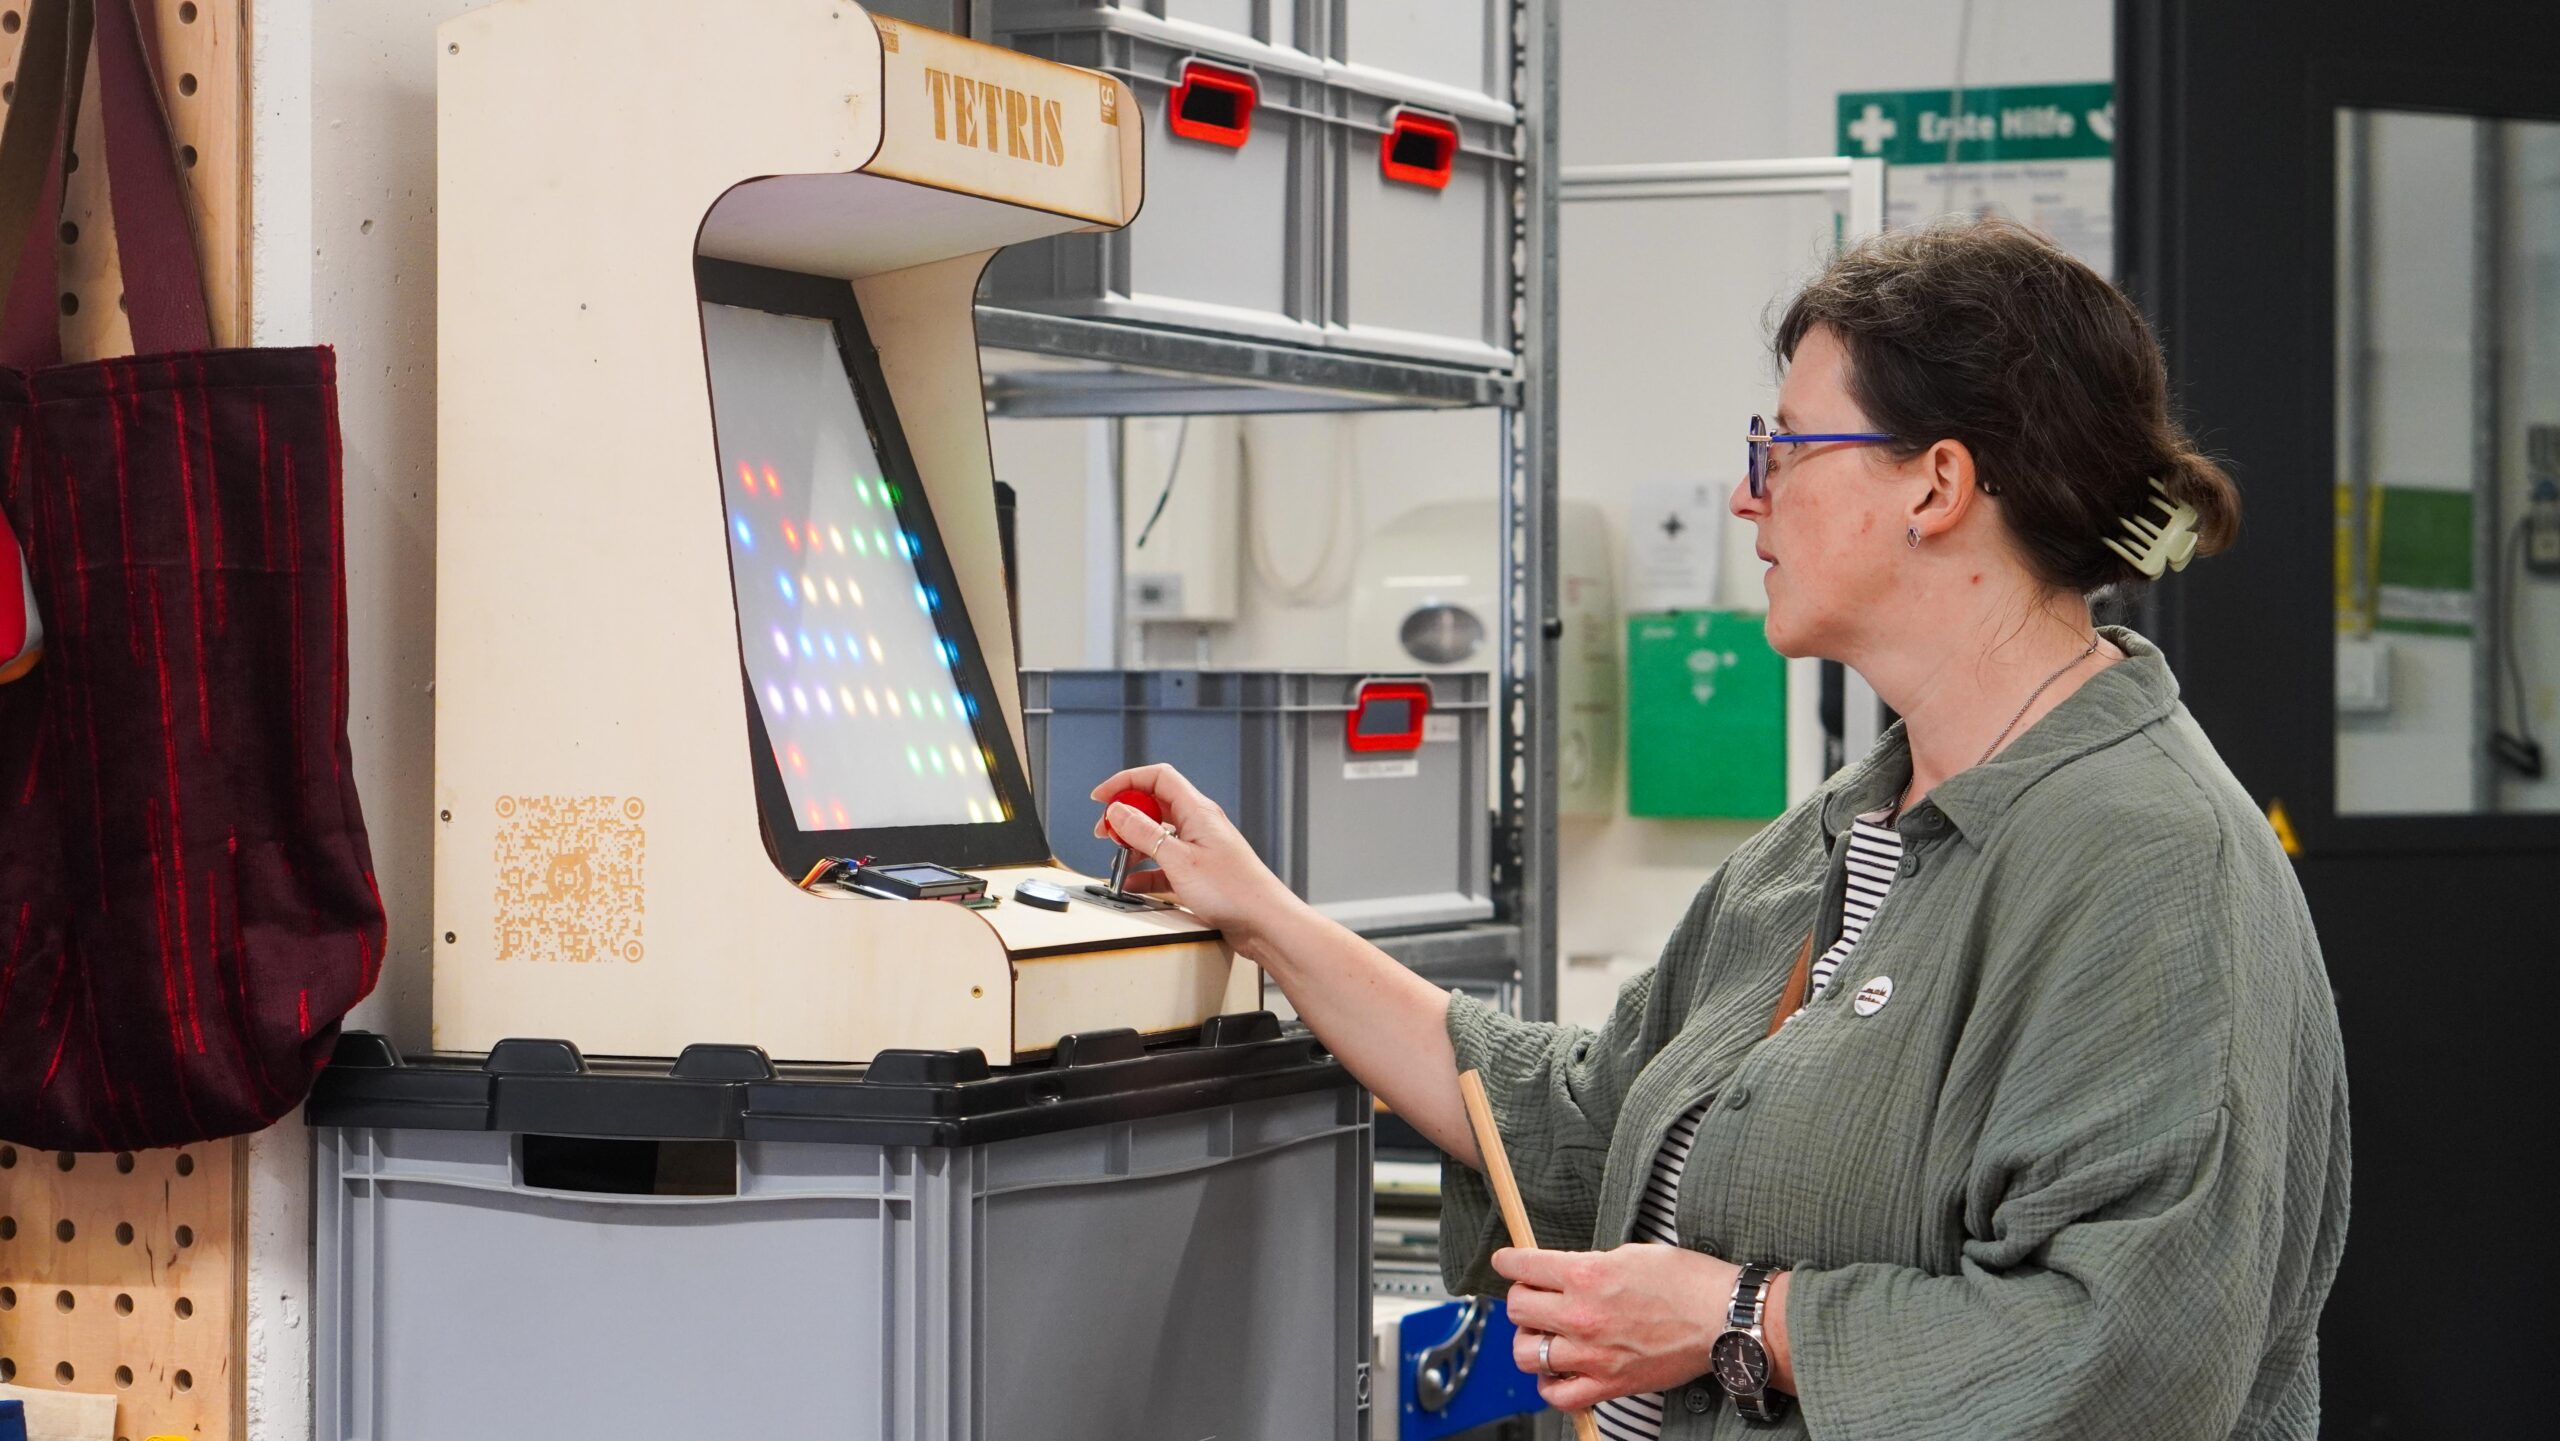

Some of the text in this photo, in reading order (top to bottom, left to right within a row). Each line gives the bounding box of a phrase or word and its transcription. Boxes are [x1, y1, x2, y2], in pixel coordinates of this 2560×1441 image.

[925, 68, 1064, 167] TETRIS
[1919, 105, 2075, 142] Erste Hilfe
